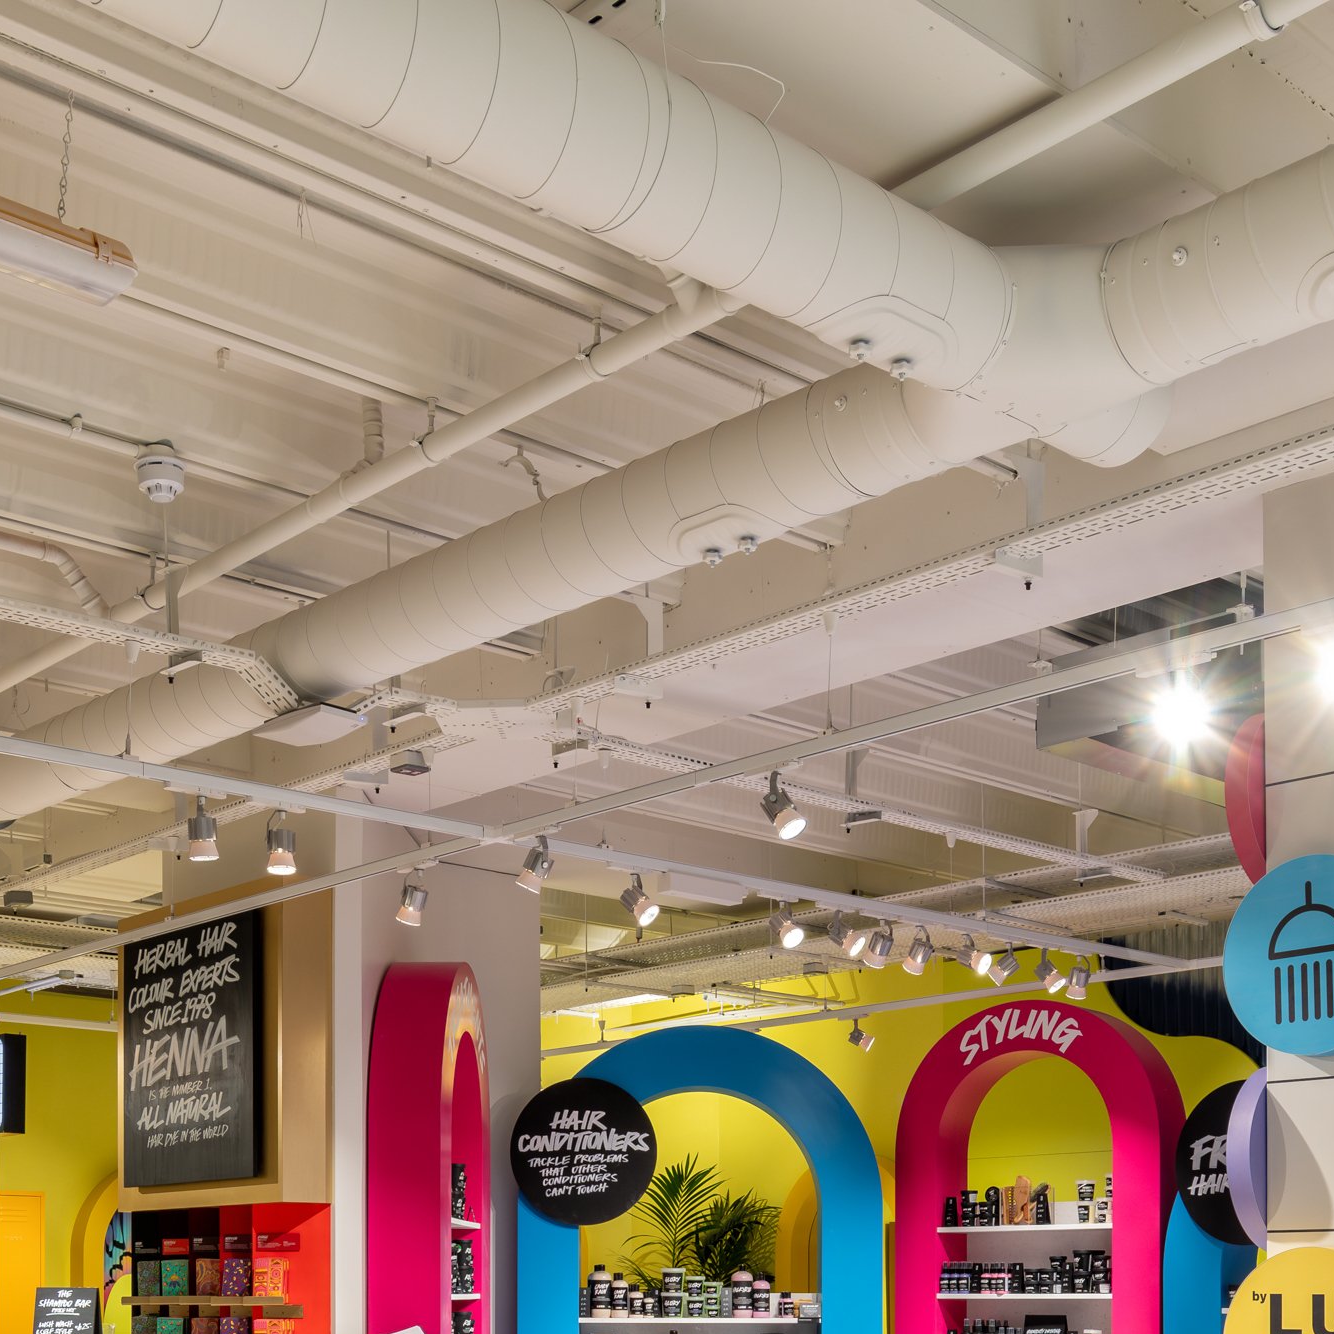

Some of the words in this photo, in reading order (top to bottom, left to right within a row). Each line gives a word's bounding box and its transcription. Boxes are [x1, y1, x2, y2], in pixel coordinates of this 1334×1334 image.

[134, 937, 193, 980] HERBAL
[197, 922, 238, 957] HAIR
[128, 977, 174, 1014] COLOUR
[178, 954, 240, 997] EXPERTS
[142, 1001, 183, 1034] SINCE
[181, 992, 216, 1024] 1978
[959, 1008, 1083, 1066] STYLING
[129, 1014, 241, 1092] HENNA
[148, 1090, 157, 1102] IS
[158, 1086, 170, 1099] THE
[172, 1080, 203, 1096] NUMBER
[137, 1105, 164, 1130] ALL
[165, 1091, 231, 1126] NATURAL
[549, 1109, 607, 1130] HAIR
[147, 1132, 163, 1148] HAIR
[164, 1129, 179, 1147] DYE
[180, 1128, 188, 1143] IN
[189, 1127, 201, 1143] THE
[202, 1124, 229, 1140] WORLD
[518, 1128, 650, 1152] CONDITIONERS
[527, 1155, 571, 1168] TACKLE
[573, 1153, 629, 1164] PROBLEMS
[539, 1165, 568, 1177] THAT
[571, 1164, 607, 1174] OTHER
[542, 1173, 618, 1187] CONDITIONERS
[576, 1182, 609, 1195] TOUCH
[38, 1299, 73, 1308] SHAMPOO
[74, 1299, 92, 1308] BAR
[57, 1290, 73, 1298] THE
[1252, 1290, 1267, 1305] by
